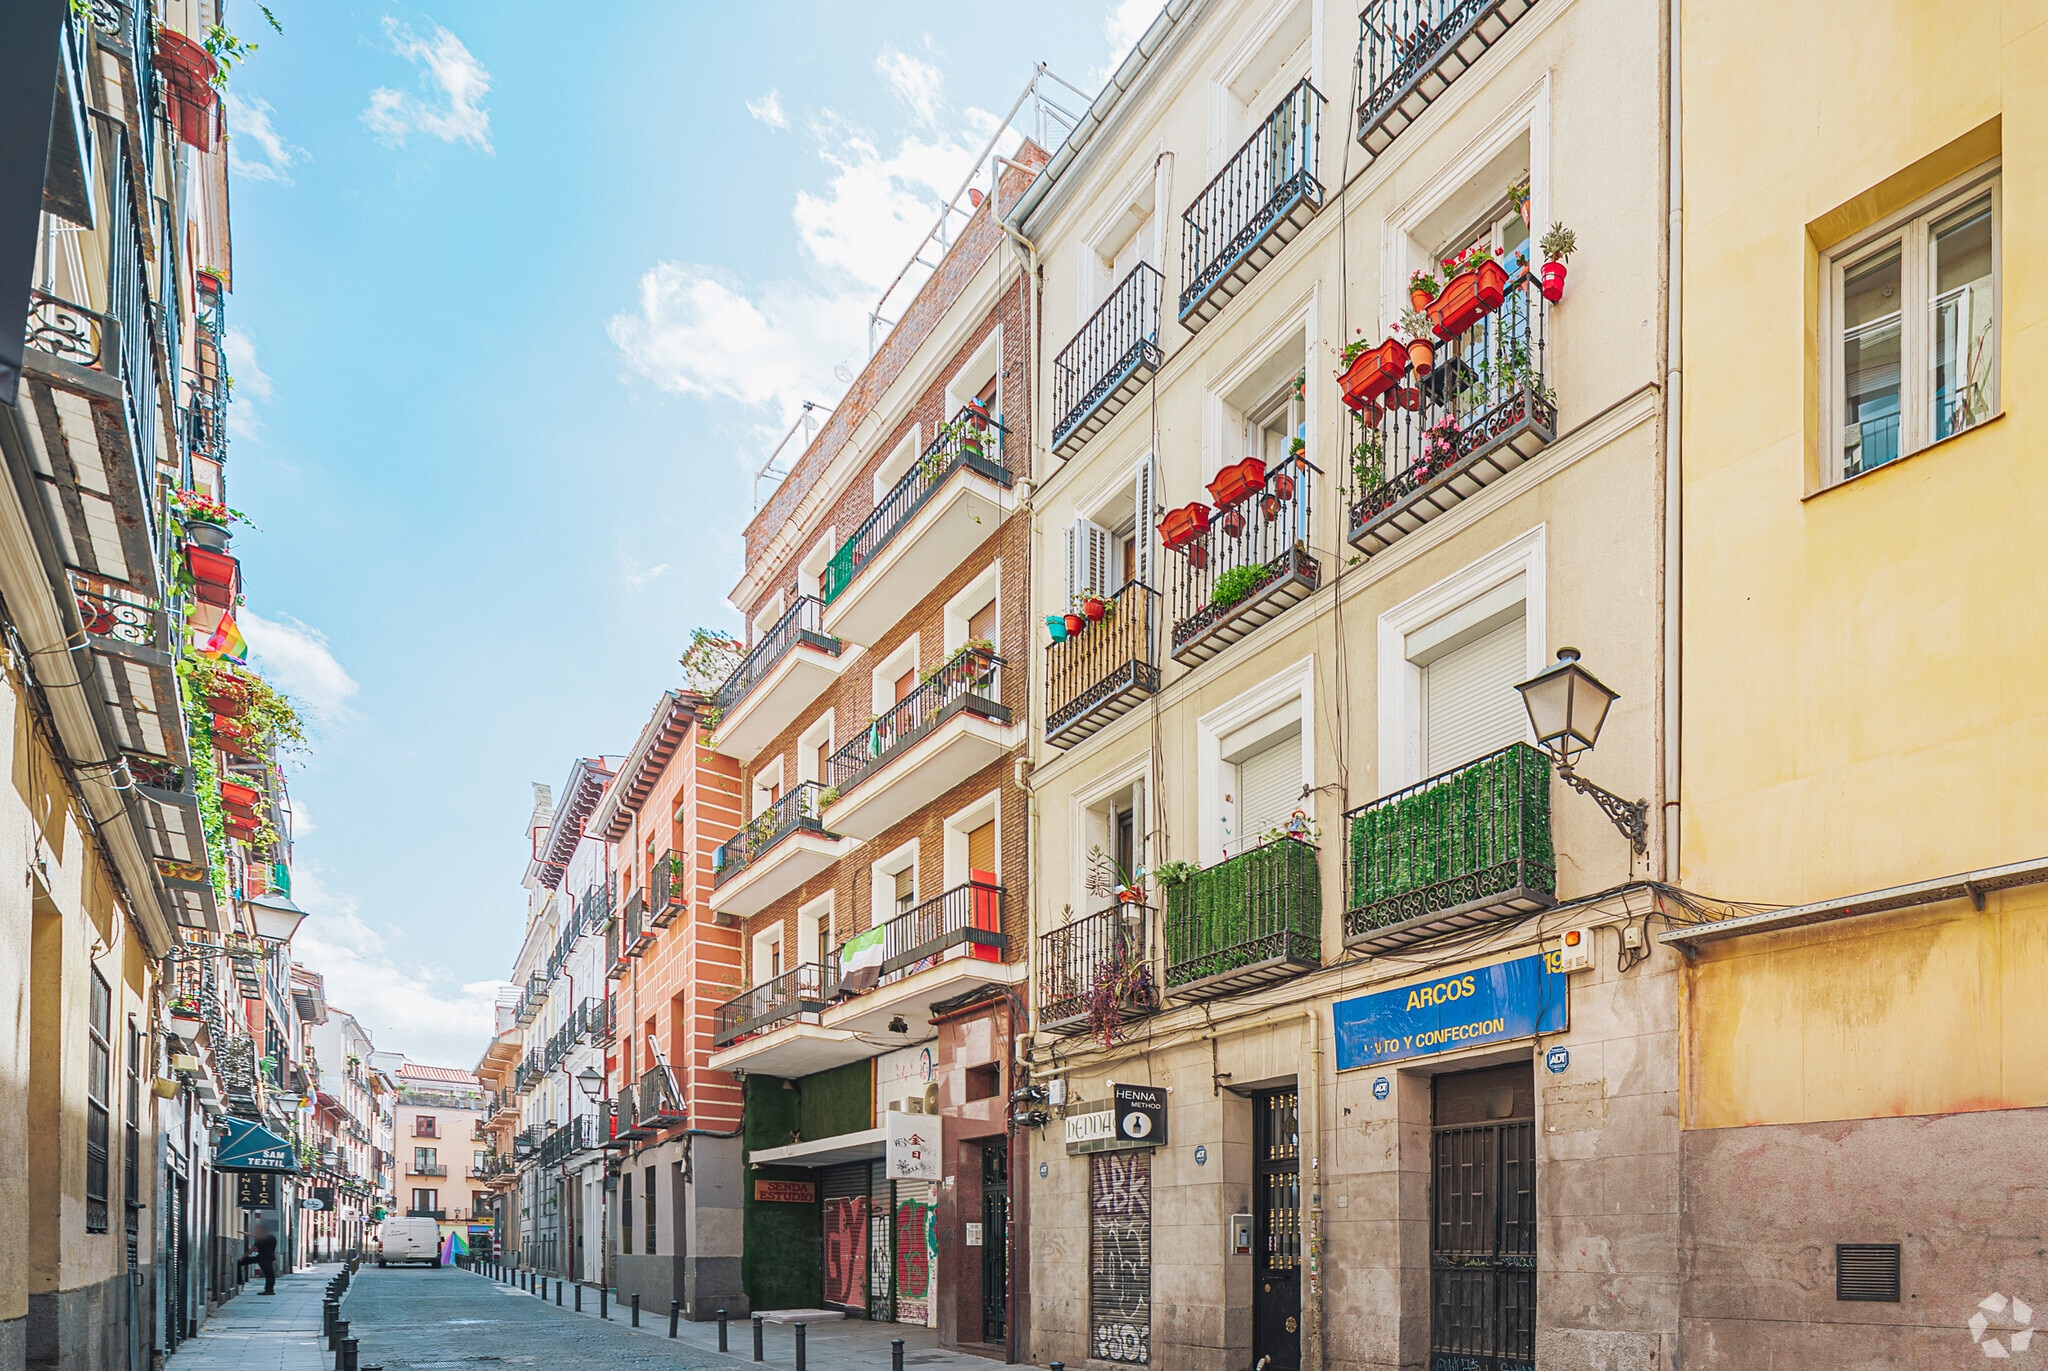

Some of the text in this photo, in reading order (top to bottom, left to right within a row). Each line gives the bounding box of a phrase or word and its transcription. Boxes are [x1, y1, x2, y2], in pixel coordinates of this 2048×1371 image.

[1543, 950, 1562, 975] 19
[1406, 976, 1475, 1012] ARCOS
[1403, 1035, 1413, 1050] Y
[1415, 1018, 1504, 1048] CONFECCION
[1550, 1052, 1566, 1065] ADT
[1116, 1089, 1156, 1102] HENNA
[1130, 1101, 1161, 1110] METHOD
[262, 1150, 285, 1160] SAM
[247, 1157, 285, 1168] TEXTIL
[767, 1181, 809, 1193] SENDA
[759, 1190, 814, 1202] ESTUDIO
